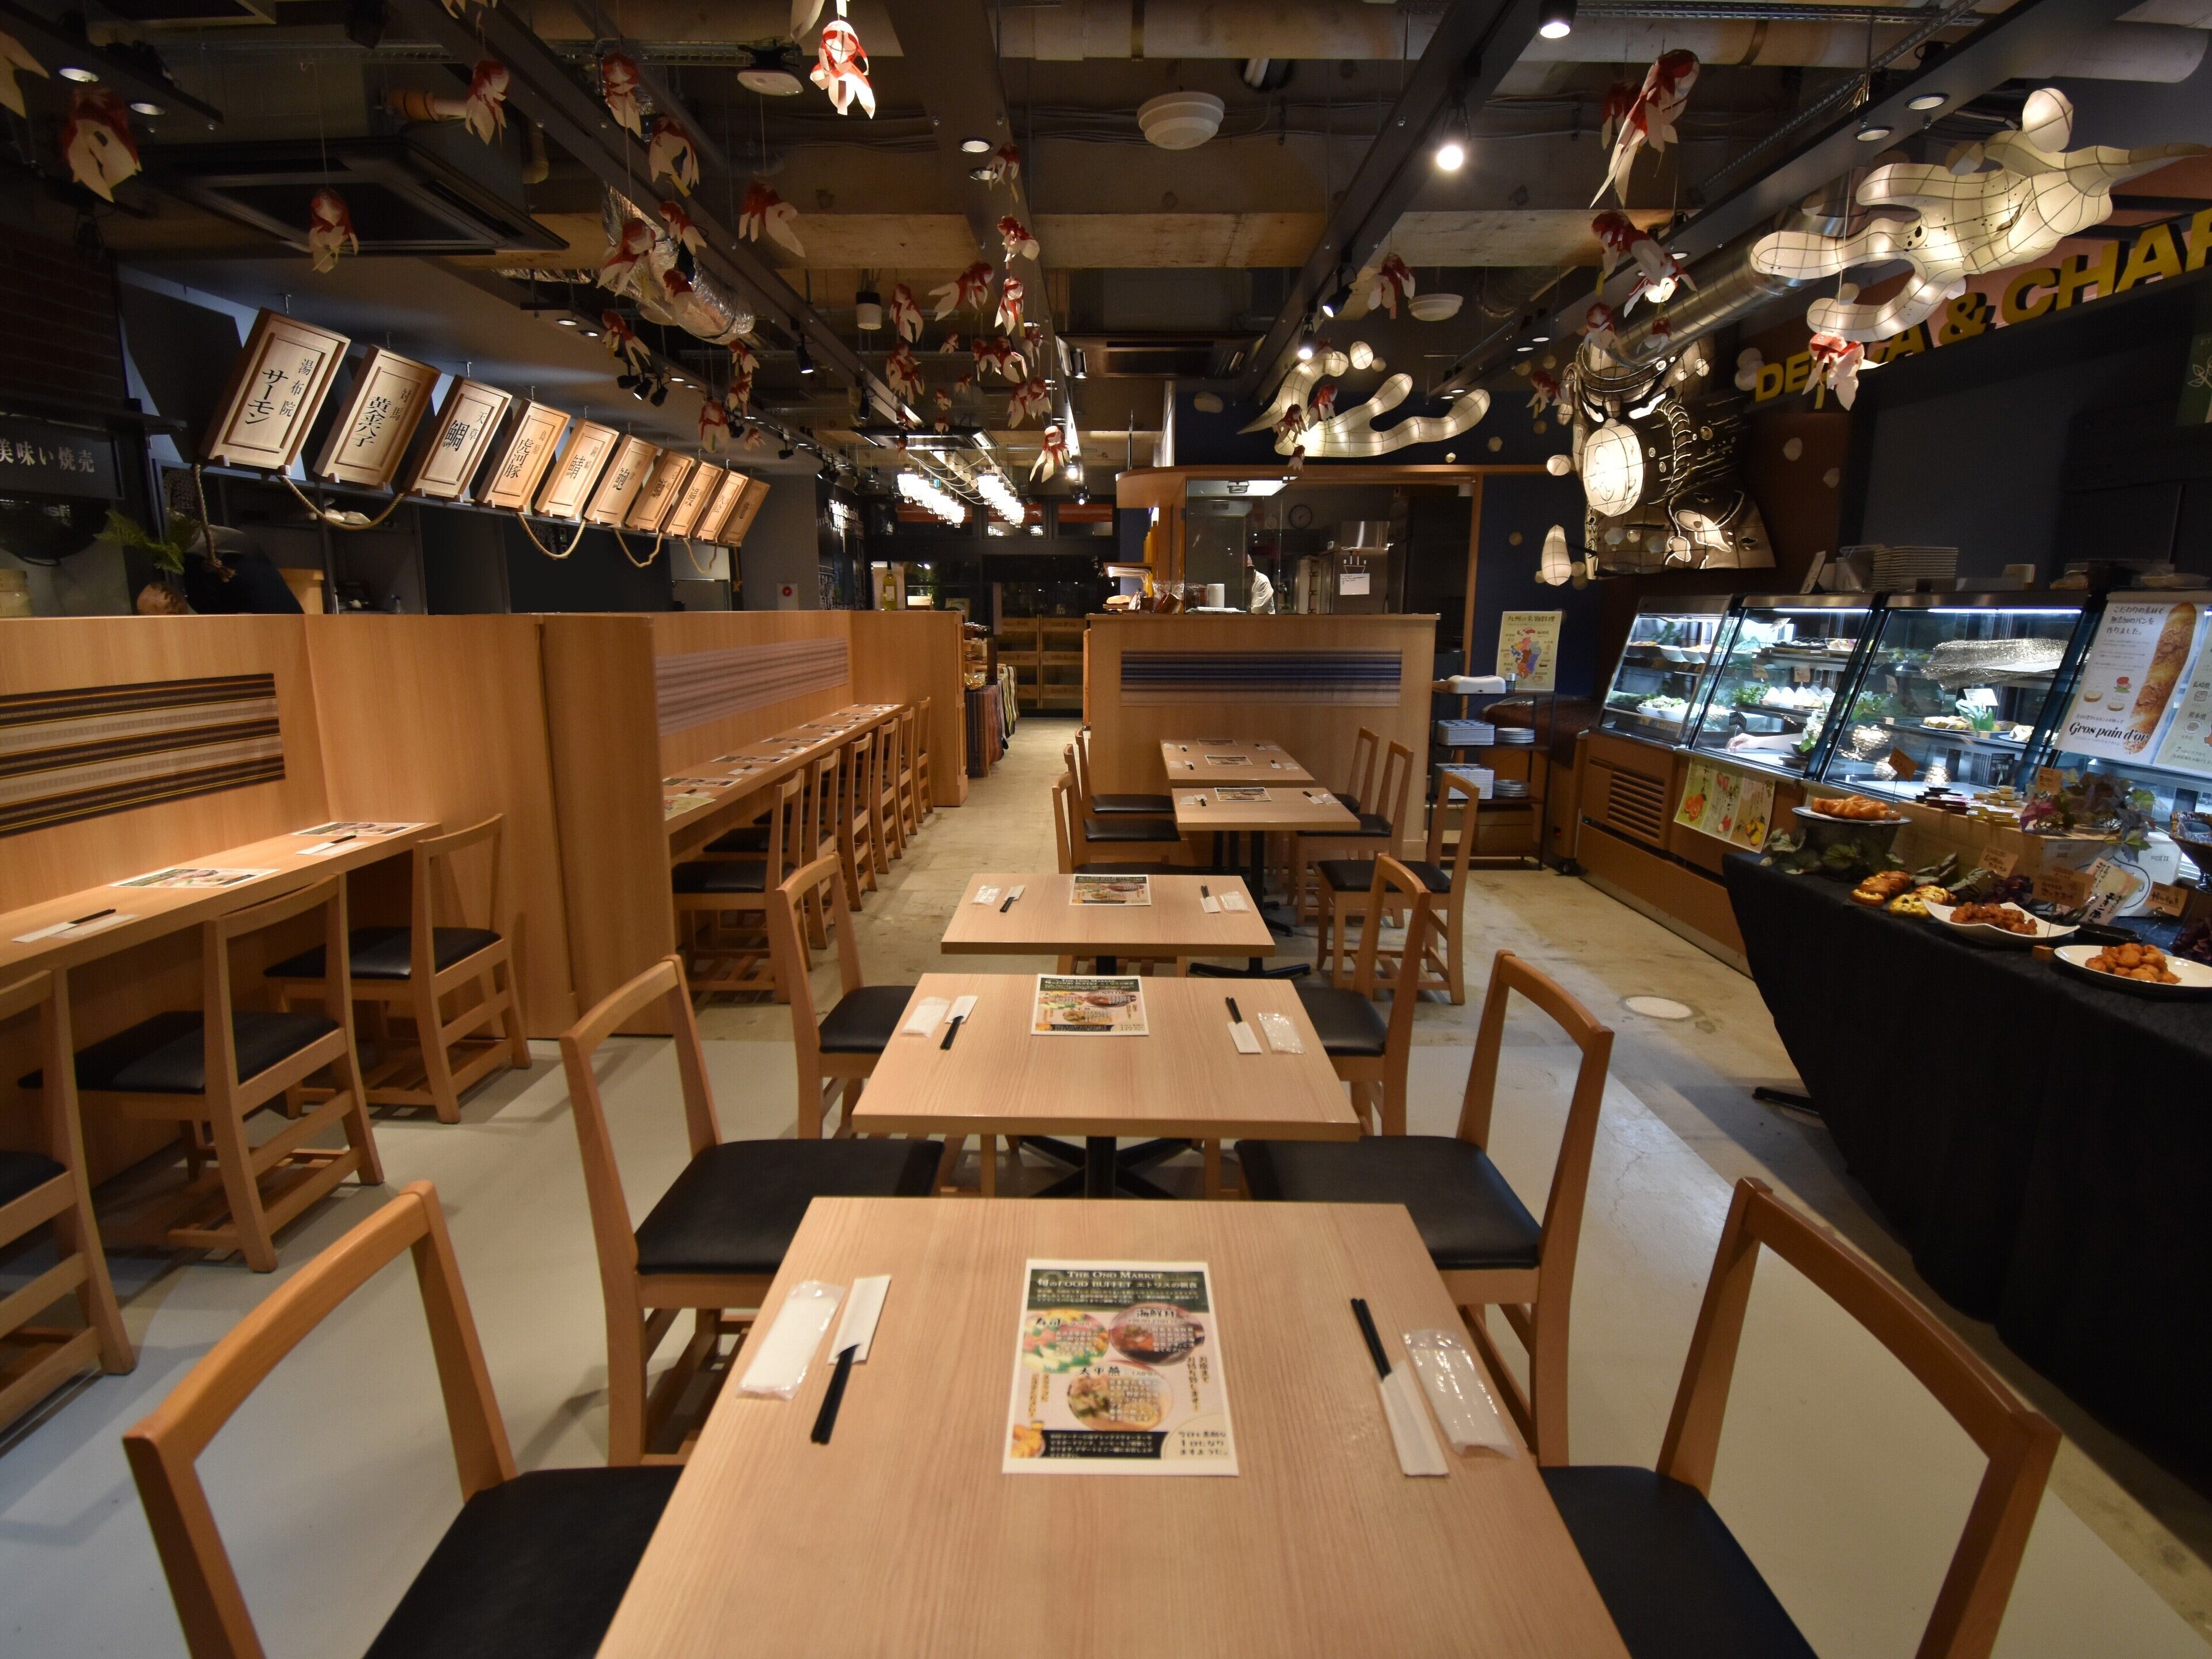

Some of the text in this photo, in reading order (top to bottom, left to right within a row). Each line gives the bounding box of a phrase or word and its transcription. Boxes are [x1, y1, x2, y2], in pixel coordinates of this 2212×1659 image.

[1938, 293, 1991, 347] &
[245, 369, 289, 425] サーモン
[279, 358, 314, 417] 湯布院
[389, 388, 412, 421] 対馬
[351, 396, 392, 447] 黄金穴子
[442, 420, 470, 452] 鯛
[468, 411, 487, 441] 天草
[0, 437, 95, 473] 美味い焼売
[504, 438, 534, 479] 虎河豚
[2106, 626, 2142, 635] 作りました。
[2069, 722, 2096, 736] Gros
[2095, 727, 2123, 739] pain
[2123, 729, 2149, 741] d'or
